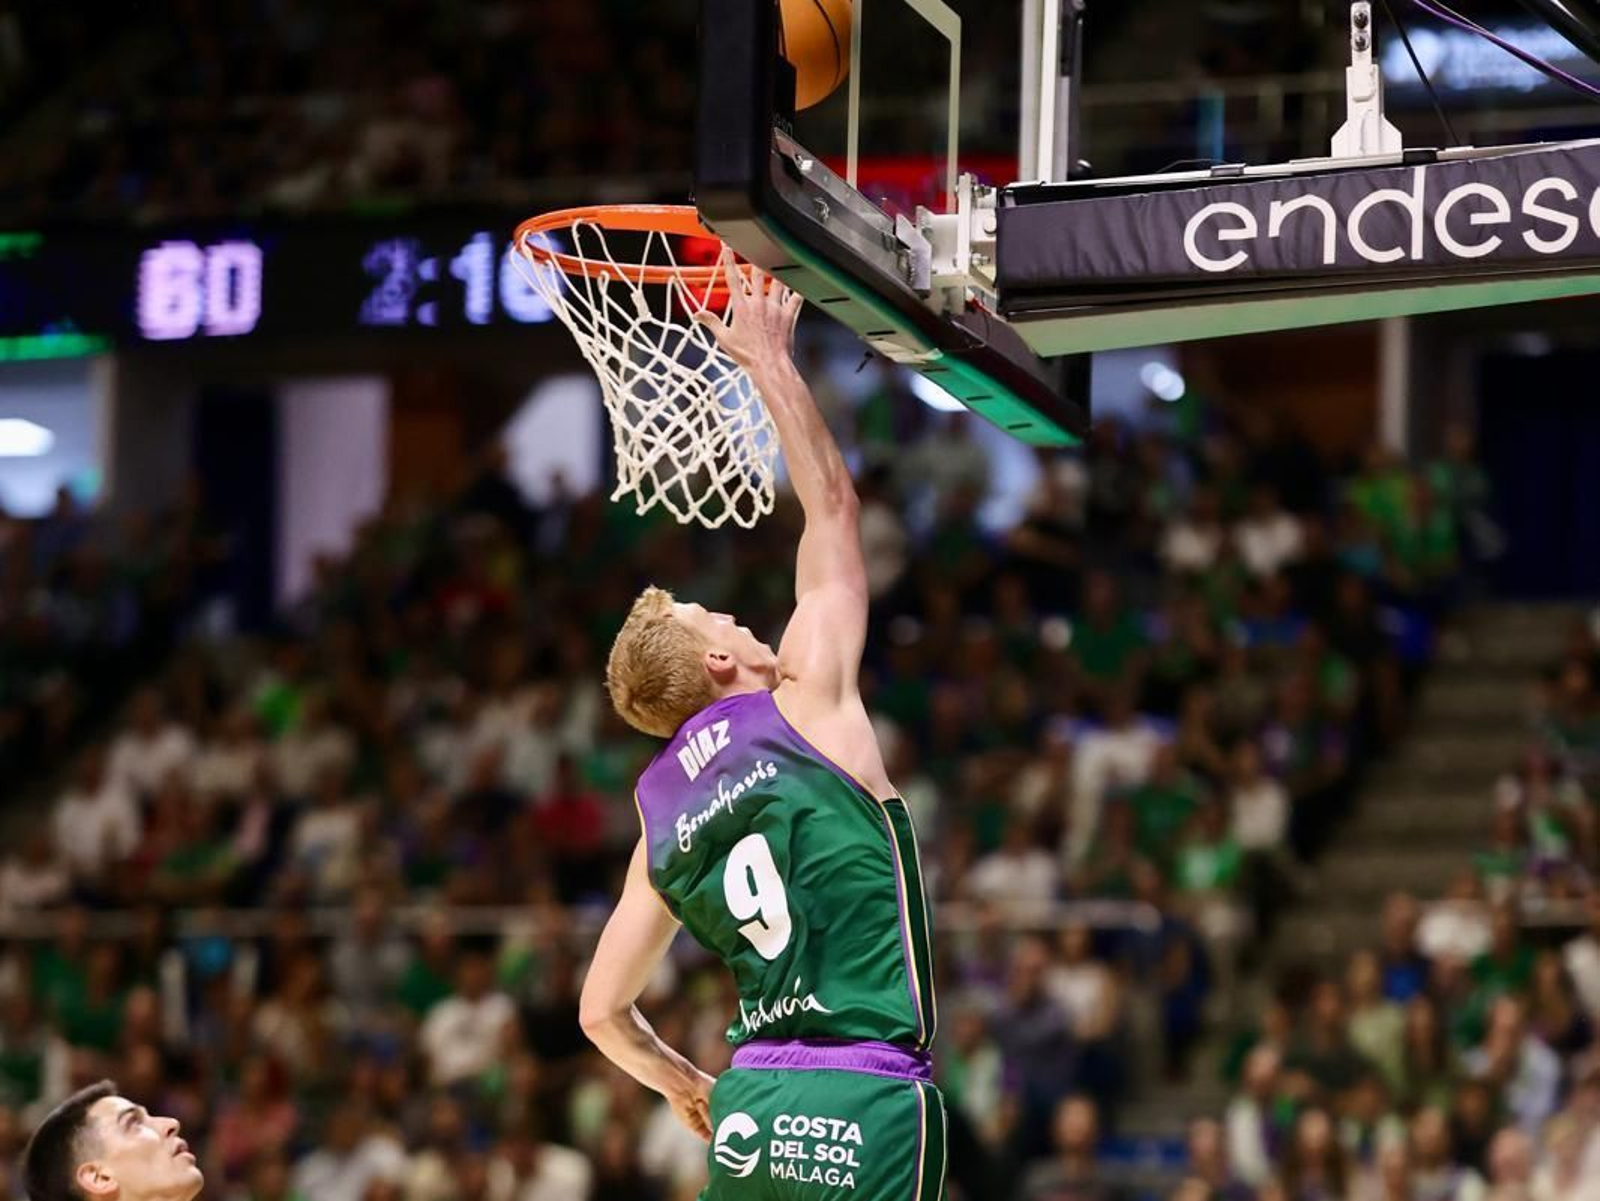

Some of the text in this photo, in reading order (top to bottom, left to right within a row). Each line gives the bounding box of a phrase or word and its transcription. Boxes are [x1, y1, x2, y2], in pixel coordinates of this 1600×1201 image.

[1183, 167, 1600, 272] endes
[138, 239, 262, 341] 60
[676, 719, 732, 782] DÍAZ
[723, 833, 792, 961] 9
[770, 1140, 860, 1168] DEL SOL
[773, 1114, 863, 1146] COSTA
[770, 1159, 855, 1189] MÁLAGA
